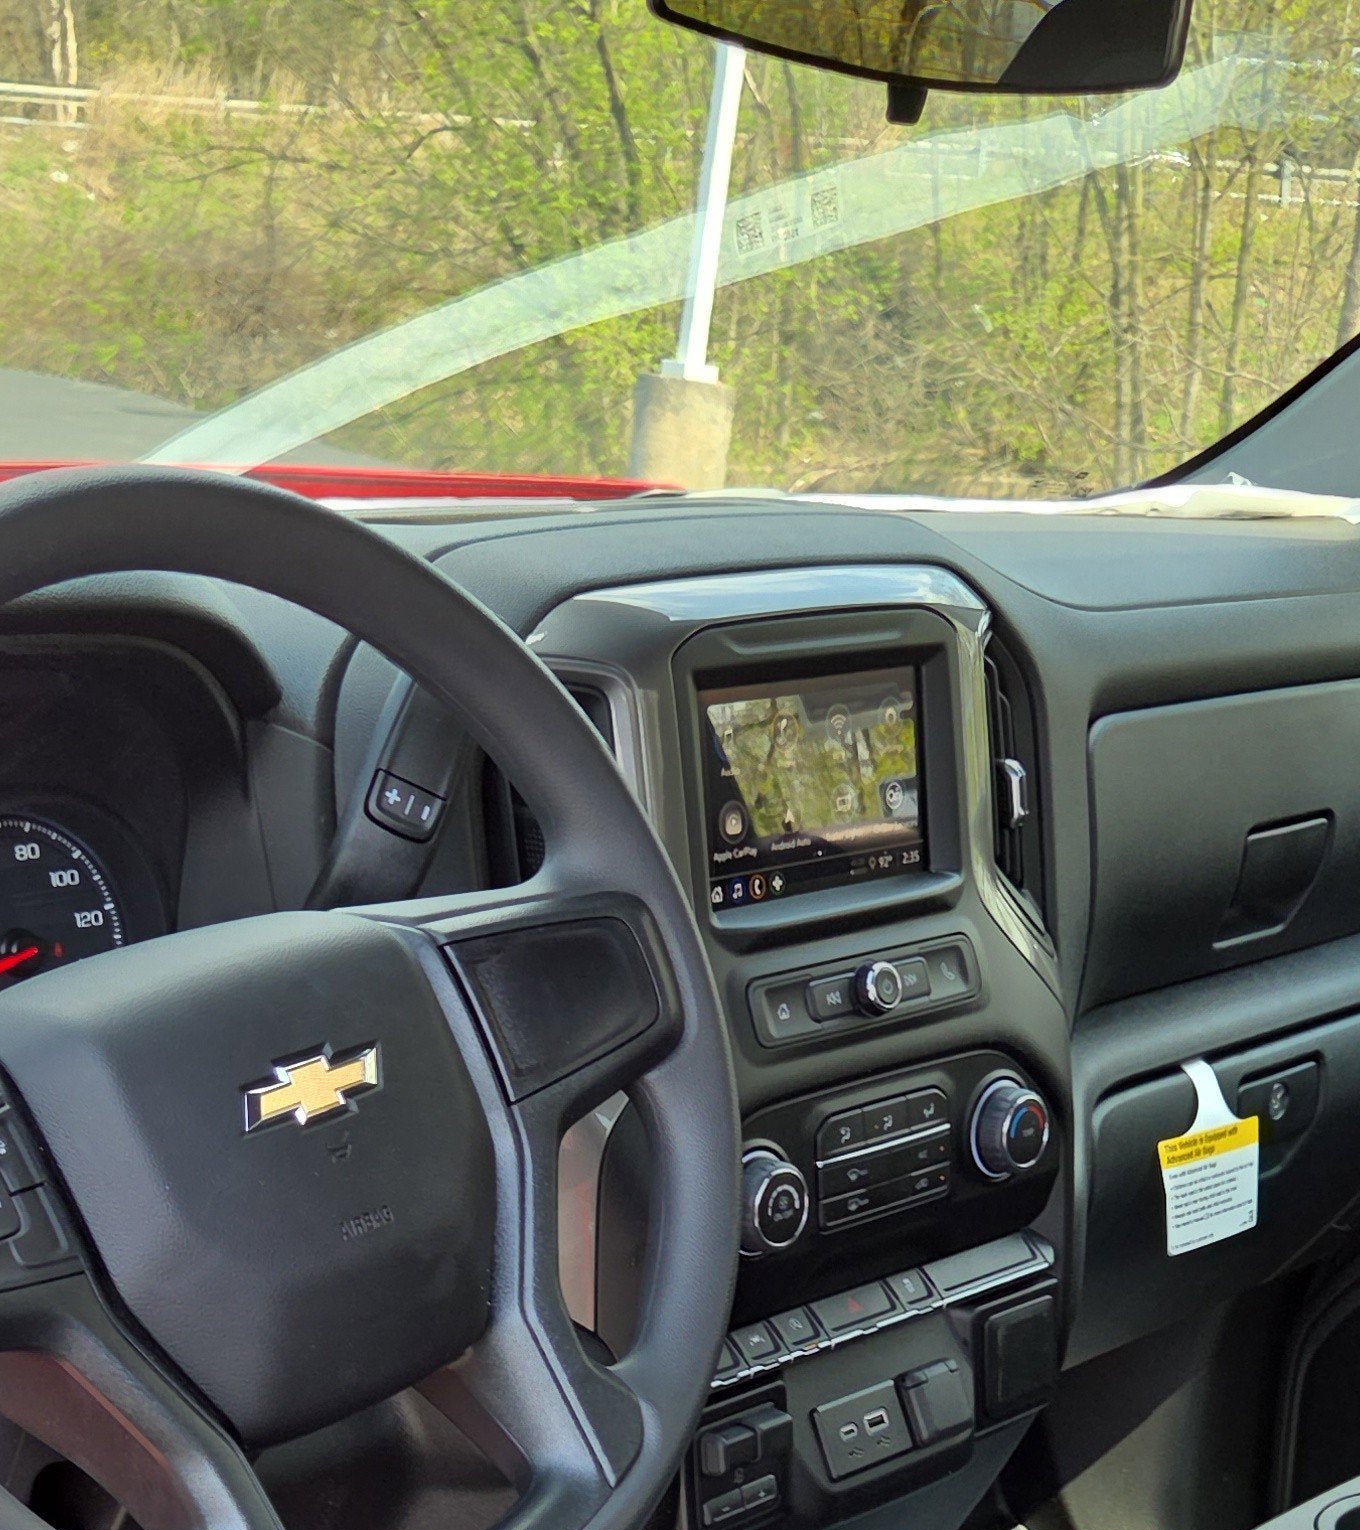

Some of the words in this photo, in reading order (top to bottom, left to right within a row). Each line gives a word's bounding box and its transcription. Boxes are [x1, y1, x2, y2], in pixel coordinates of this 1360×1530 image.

[14, 843, 41, 861] 80
[49, 869, 80, 887] 100
[74, 910, 104, 928] 120
[1178, 1138, 1198, 1149] Vehicle
